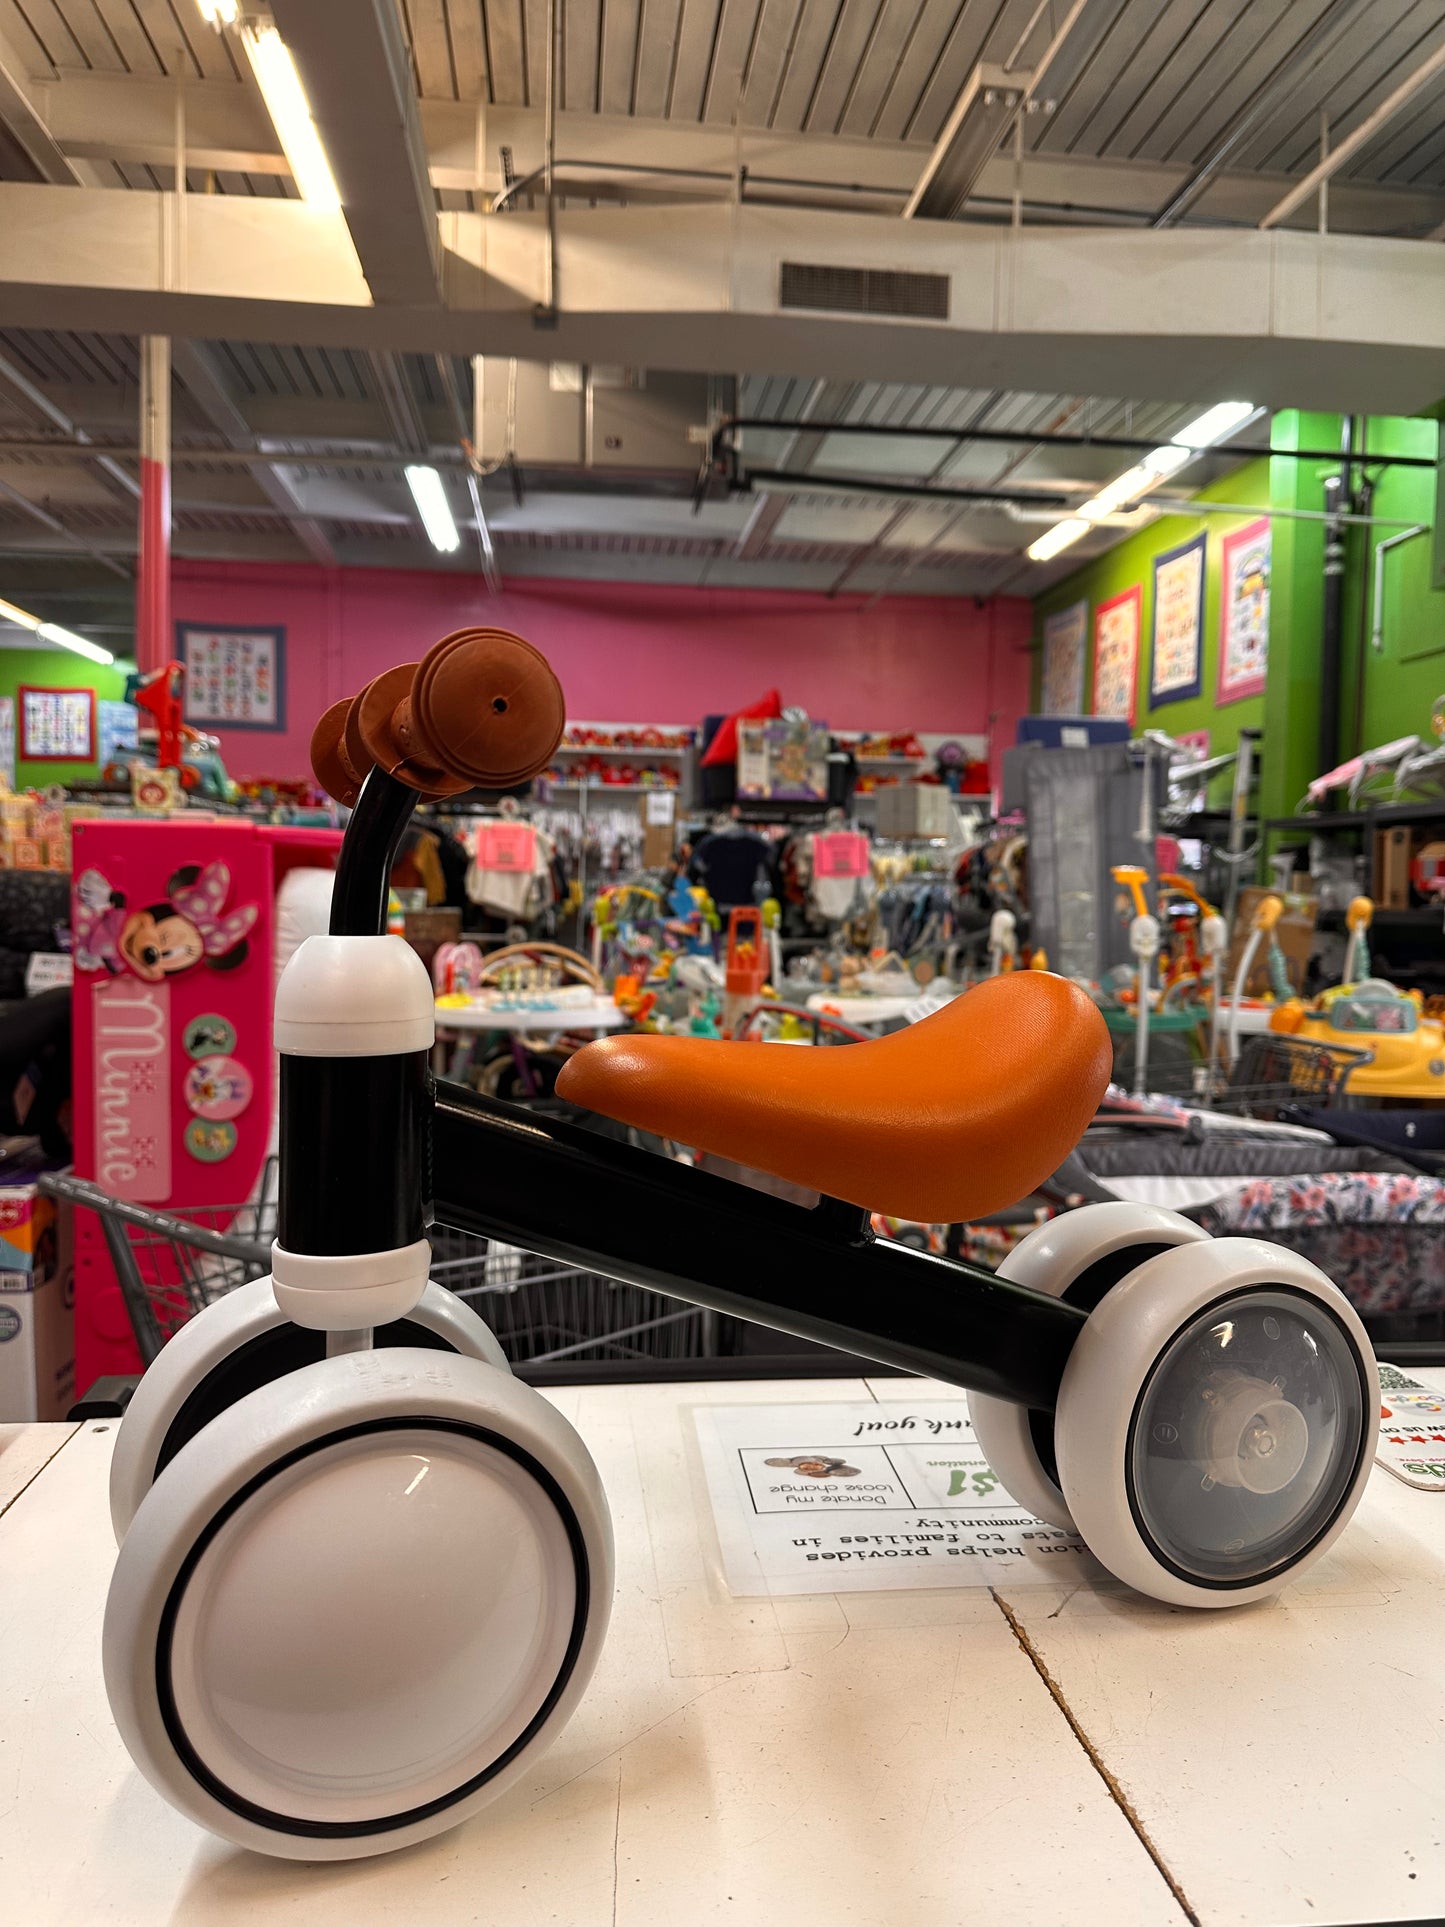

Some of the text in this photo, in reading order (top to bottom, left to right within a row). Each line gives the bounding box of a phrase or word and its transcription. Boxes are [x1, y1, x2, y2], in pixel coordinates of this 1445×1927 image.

[98, 993, 164, 1186] Minnie
[853, 1416, 918, 1437] you!
[926, 1461, 987, 1469] onation
[768, 1484, 894, 1494] loose change
[946, 1468, 999, 1497] $1
[785, 1495, 887, 1505] Donate my
[791, 1530, 1081, 1549] eats to families in
[806, 1547, 931, 1562] provides
[946, 1546, 1025, 1558] helps
